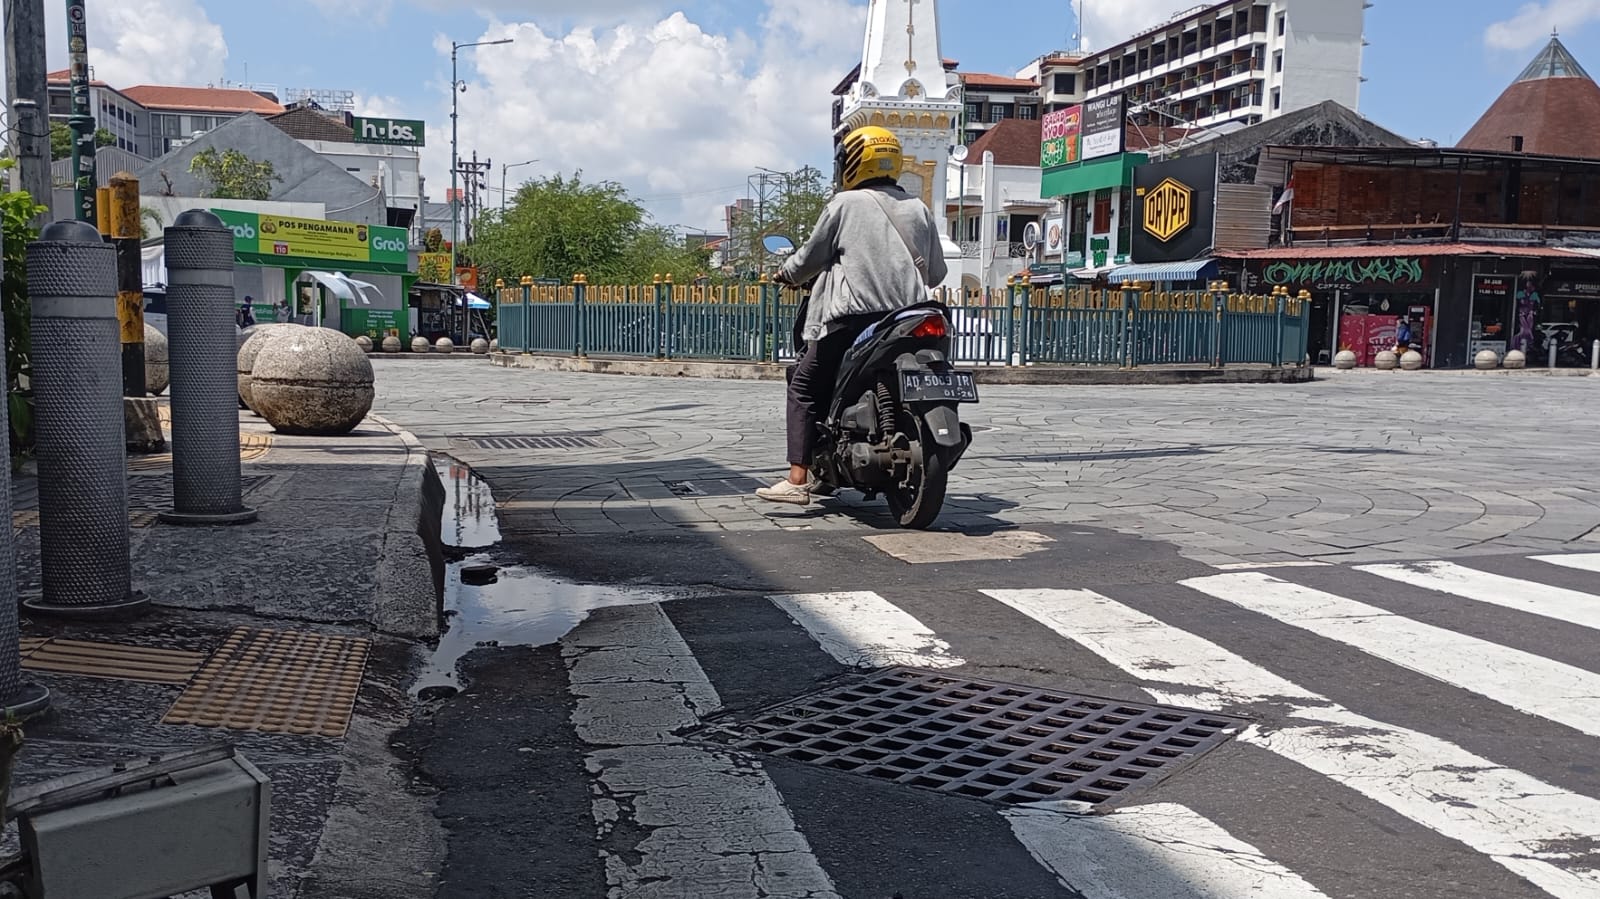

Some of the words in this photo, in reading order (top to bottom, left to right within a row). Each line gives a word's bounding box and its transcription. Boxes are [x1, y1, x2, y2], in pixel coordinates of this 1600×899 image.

[278, 220, 296, 229] POS
[297, 222, 354, 235] PENGAMANAN
[275, 245, 287, 254] 110
[372, 236, 406, 252] Grab
[906, 375, 920, 387] AD
[957, 375, 970, 387] IR
